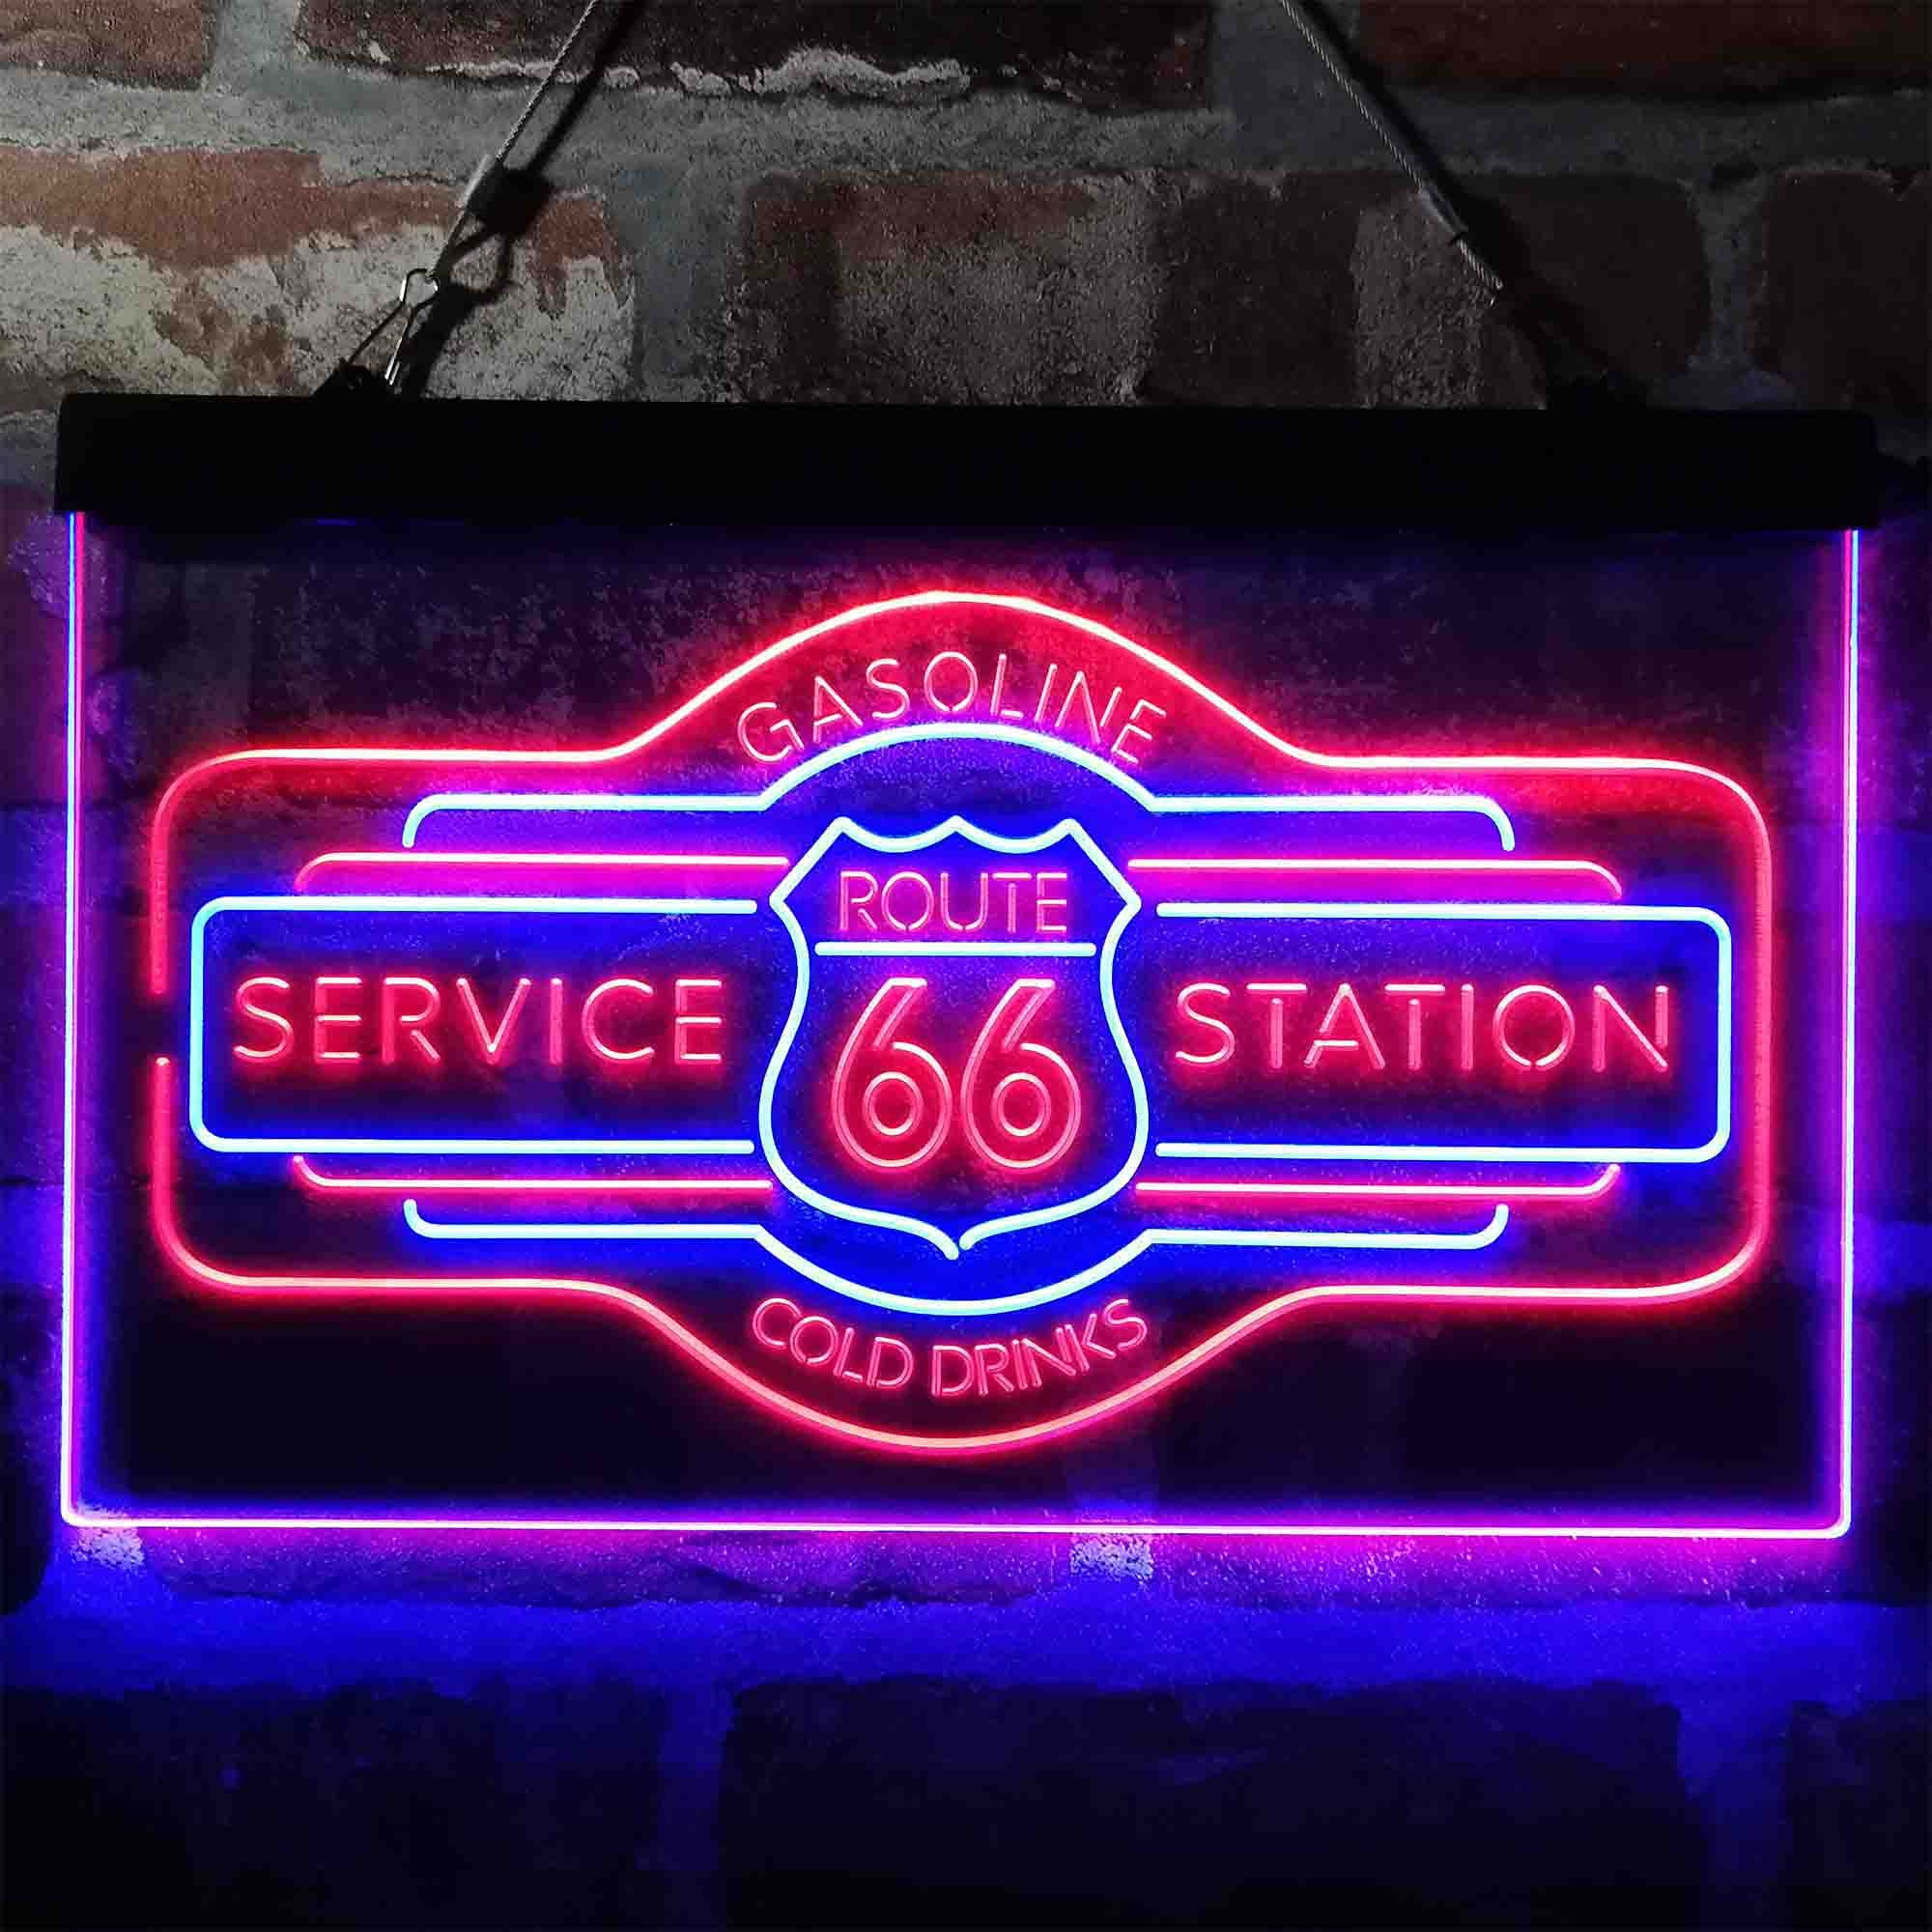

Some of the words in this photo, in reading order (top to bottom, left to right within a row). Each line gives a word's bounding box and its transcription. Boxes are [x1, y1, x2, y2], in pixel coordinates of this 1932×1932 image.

[737, 652, 1167, 764] GASOLINE
[838, 870, 1068, 934] ROUTE
[233, 976, 724, 1065] SERVICE
[1175, 981, 1669, 1071] STATION
[831, 978, 1083, 1169] 66
[752, 1297, 914, 1389] COLD
[930, 1298, 1148, 1397] DRINKS
